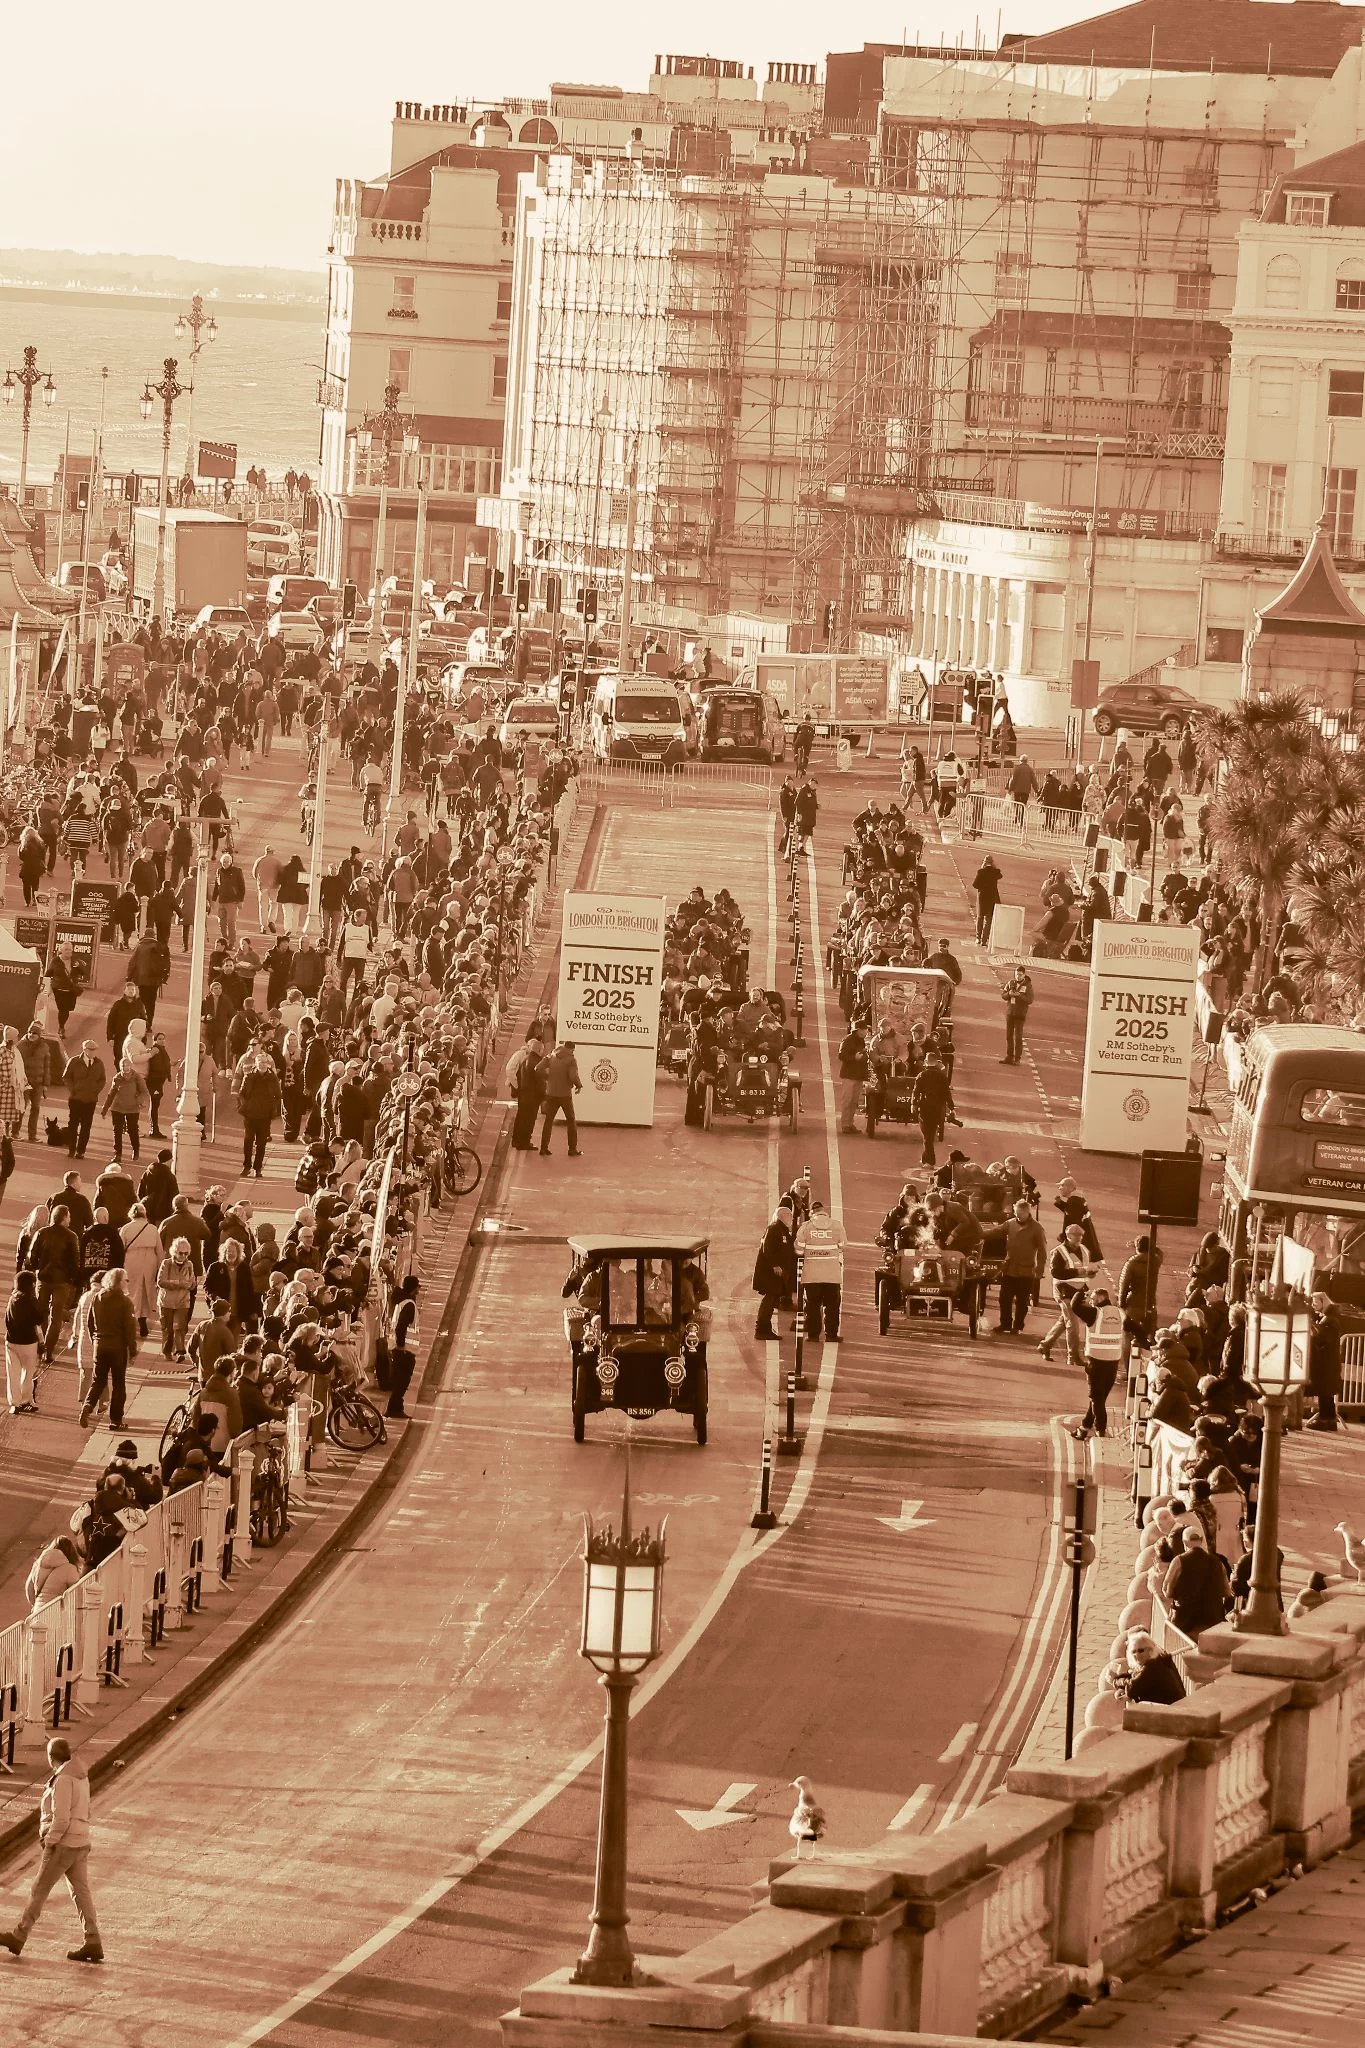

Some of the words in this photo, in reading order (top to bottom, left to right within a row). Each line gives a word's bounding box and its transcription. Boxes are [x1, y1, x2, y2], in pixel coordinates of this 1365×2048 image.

[766, 680, 788, 690] ASDA
[569, 913, 603, 928] LONDON
[605, 915, 615, 926] TO
[617, 915, 659, 933] BRIGHTON
[57, 932, 92, 944] TAKEAWAY
[74, 945, 91, 954] CHIPS
[1104, 943, 1138, 957] LONDON
[1139, 944, 1149, 956] TO
[1151, 946, 1193, 963] BRIGHTON
[567, 962, 654, 986] FINISH
[582, 988, 635, 1009] 2025
[1100, 992, 1188, 1016] FINISH
[573, 1011, 591, 1020] RM
[594, 1012, 642, 1024] Sotheby's
[565, 1021, 605, 1031] Veteran
[608, 1023, 627, 1032] Car
[630, 1025, 649, 1033] Run
[1115, 1018, 1168, 1040] 2025
[1106, 1041, 1124, 1049] RM
[1126, 1042, 1175, 1054] Sotheby's
[1098, 1051, 1138, 1061] Veteran
[1140, 1053, 1160, 1062] Car
[1162, 1055, 1182, 1064] Run
[1320, 1152, 1346, 1160] VETERAN
[1307, 1177, 1344, 1188] VETERAN
[1345, 1182, 1361, 1190] CAR
[601, 1388, 613, 1396] 348
[627, 1407, 638, 1415] BS
